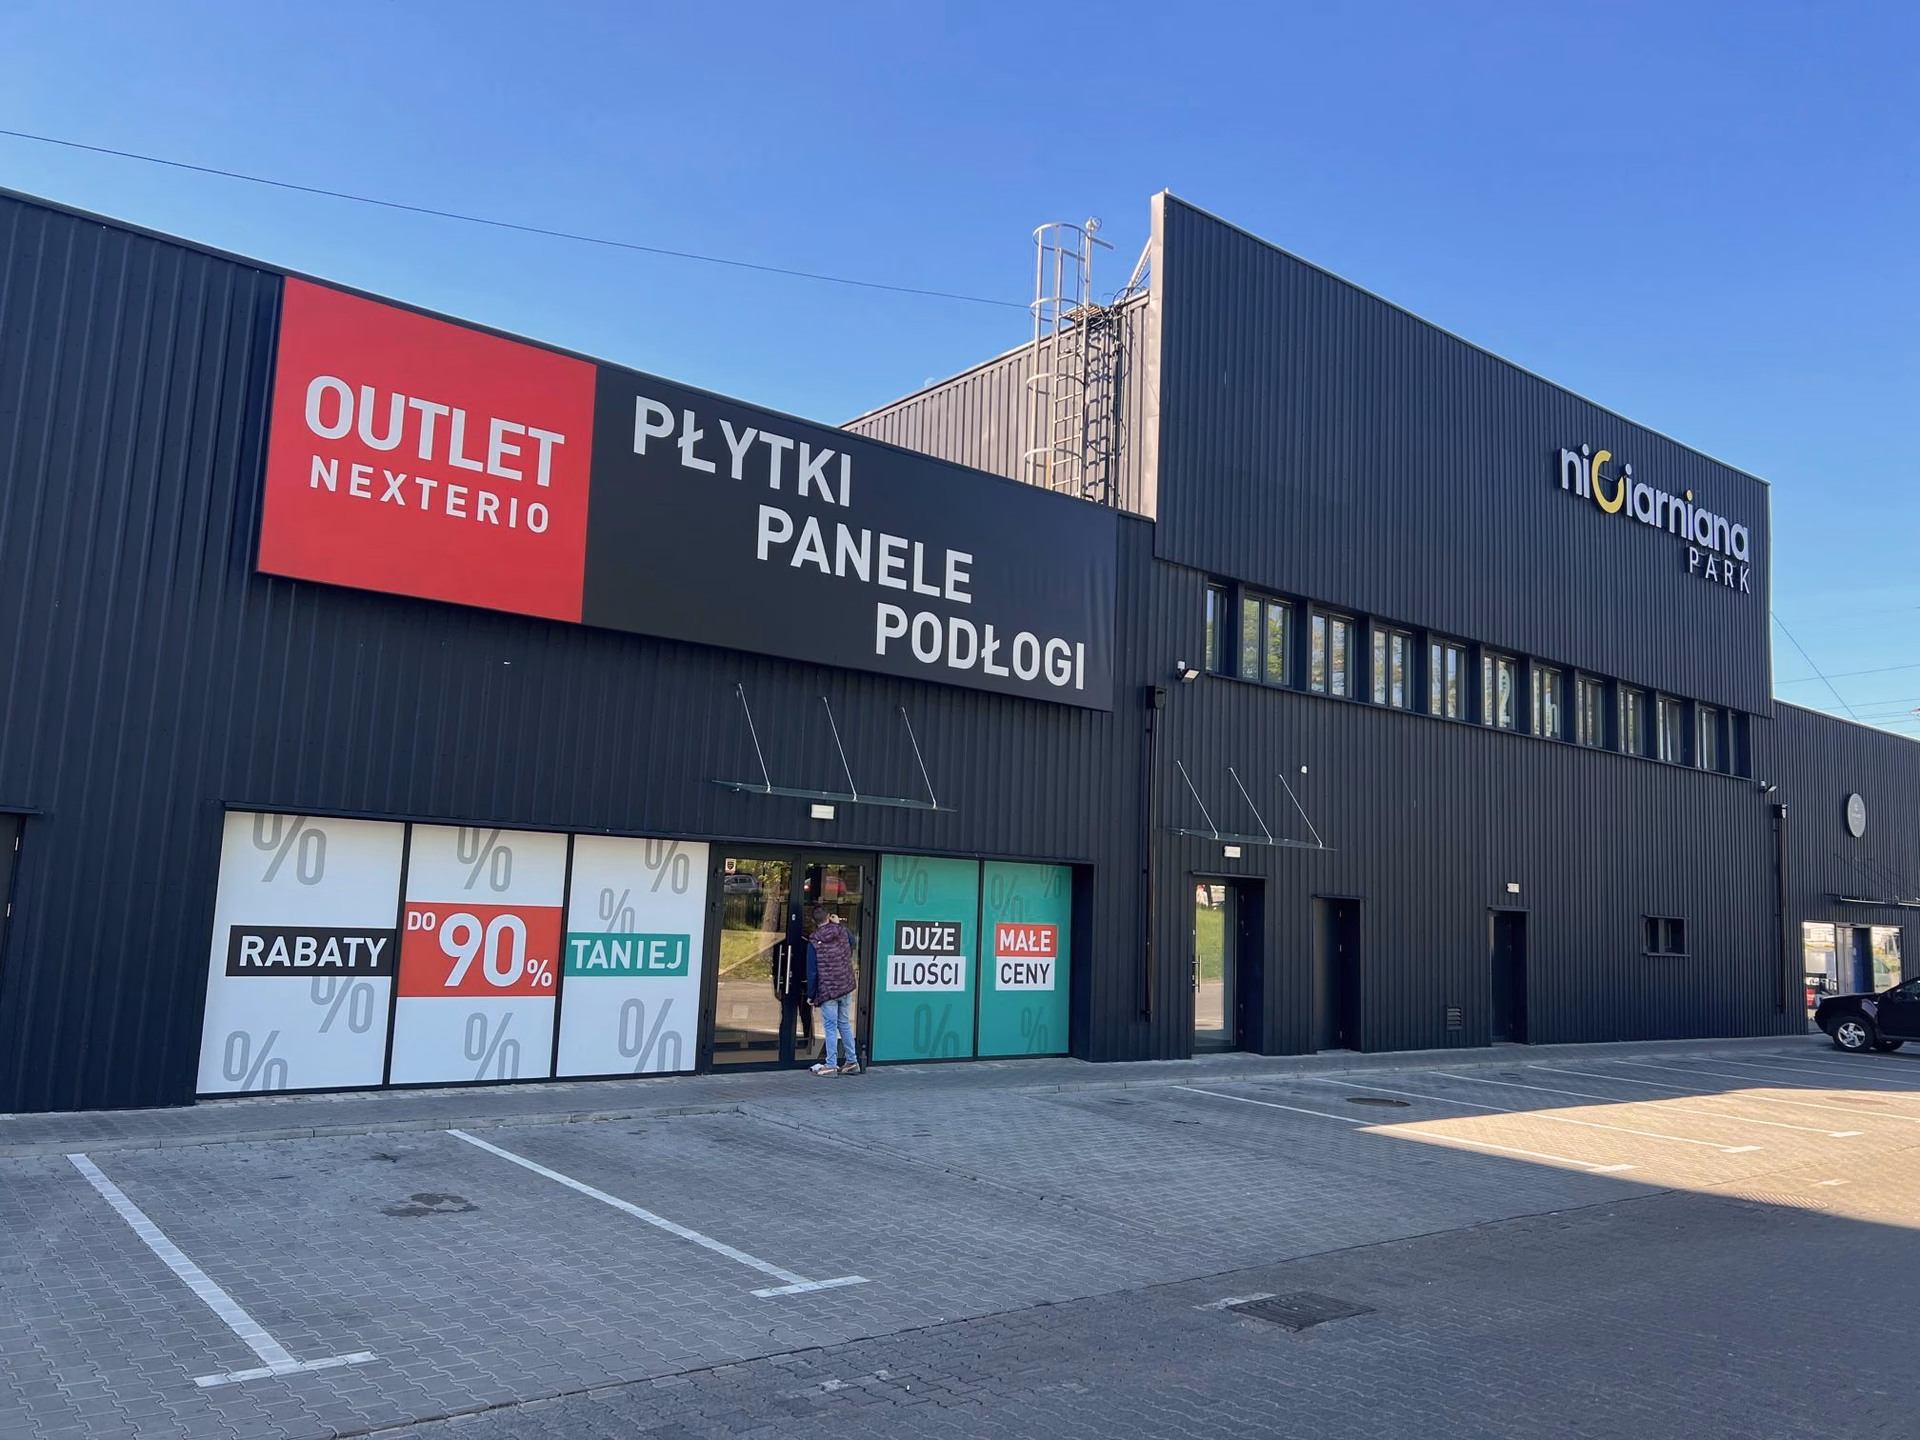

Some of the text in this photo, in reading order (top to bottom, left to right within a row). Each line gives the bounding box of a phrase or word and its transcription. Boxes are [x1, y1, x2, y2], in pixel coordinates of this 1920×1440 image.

[305, 375, 565, 487] OUTLET
[633, 395, 852, 507] PŁYTKI
[310, 455, 549, 533] NEXTERIO
[757, 504, 973, 603] PANELE
[1689, 546, 1750, 594] PARK
[875, 602, 1085, 690] PODŁOGI
[239, 935, 388, 967] RABATY
[407, 911, 552, 988] DO 90%
[571, 940, 683, 970] TANIEJ
[902, 921, 956, 951] DUŻE
[1000, 929, 1052, 952] MAŁE
[893, 955, 959, 985] ILOŚCI
[1000, 963, 1050, 984] CENY
